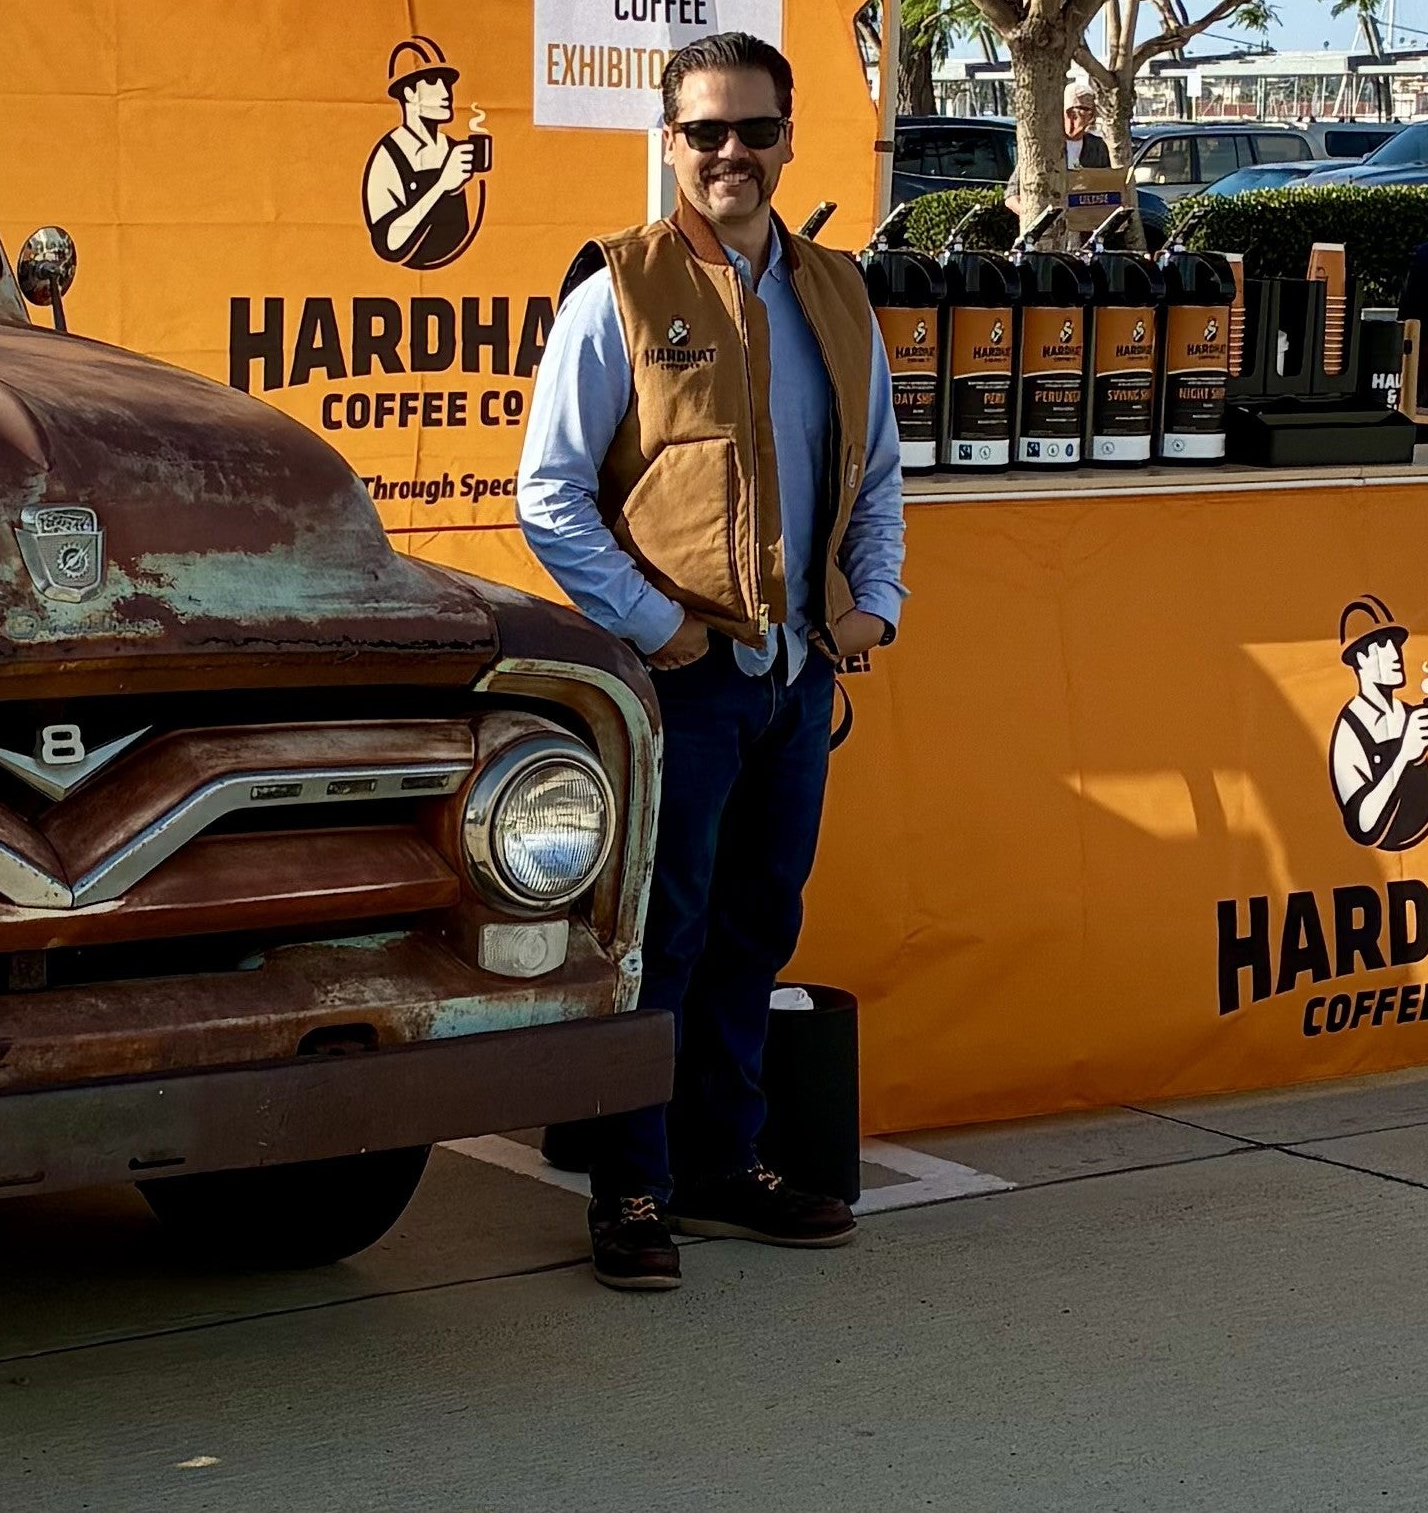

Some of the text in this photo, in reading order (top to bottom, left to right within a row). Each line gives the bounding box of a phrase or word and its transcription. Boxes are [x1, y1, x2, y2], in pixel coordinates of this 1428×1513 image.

[547, 42, 679, 90] EXHIBITO
[229, 297, 558, 394] HARDHA
[322, 391, 468, 430] COFFEE
[894, 392, 914, 405] DAY
[362, 472, 454, 505] Through
[41, 724, 86, 765] 8
